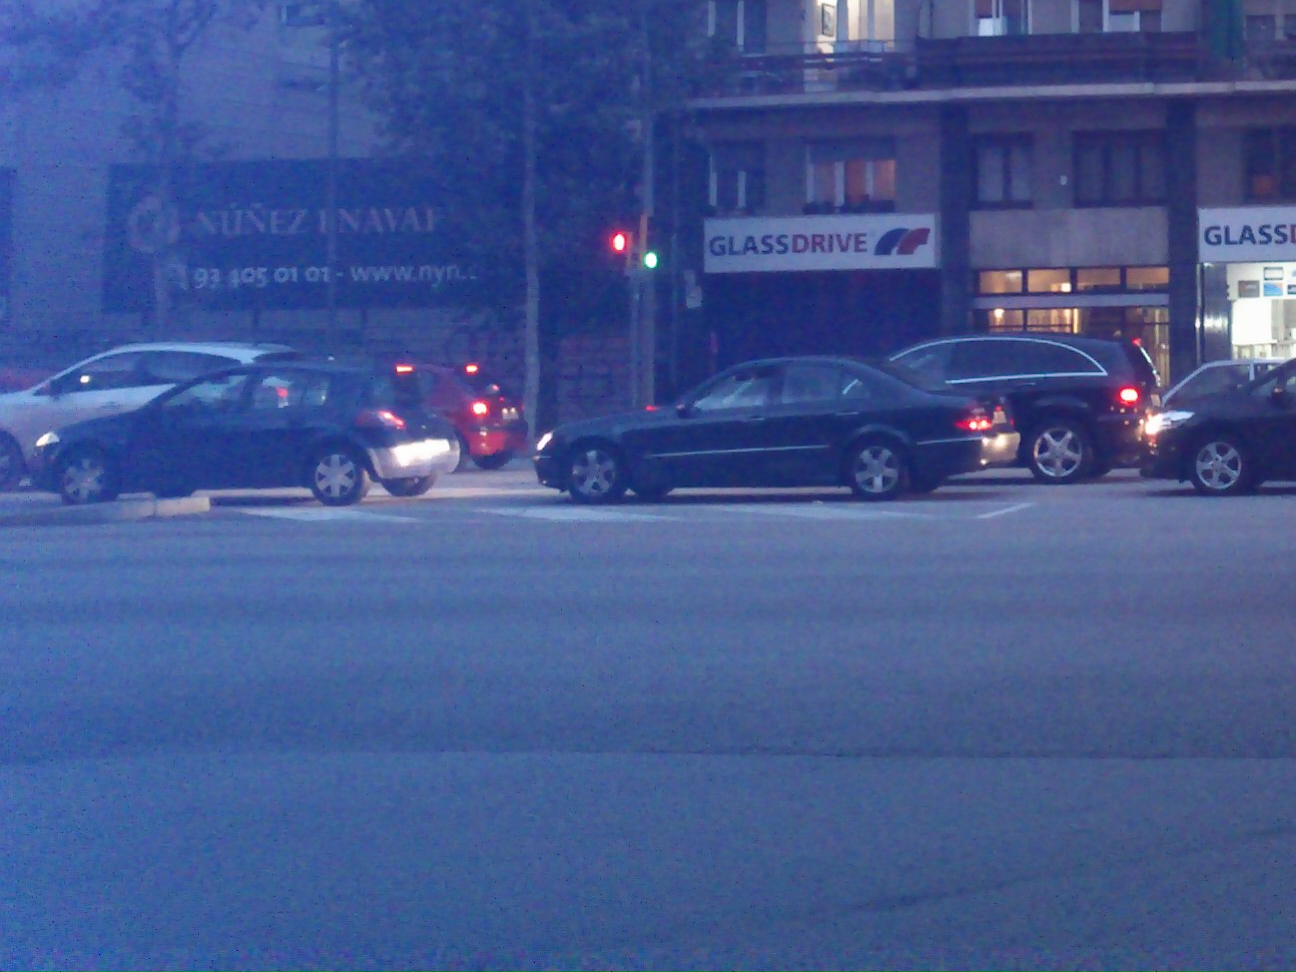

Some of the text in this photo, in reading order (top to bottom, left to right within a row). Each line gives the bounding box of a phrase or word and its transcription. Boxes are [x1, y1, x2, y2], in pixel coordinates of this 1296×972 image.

[709, 232, 868, 256] GLASSDRIVE
[193, 266, 221, 289] 93
[273, 266, 298, 283] 01
[304, 266, 330, 283] 01
